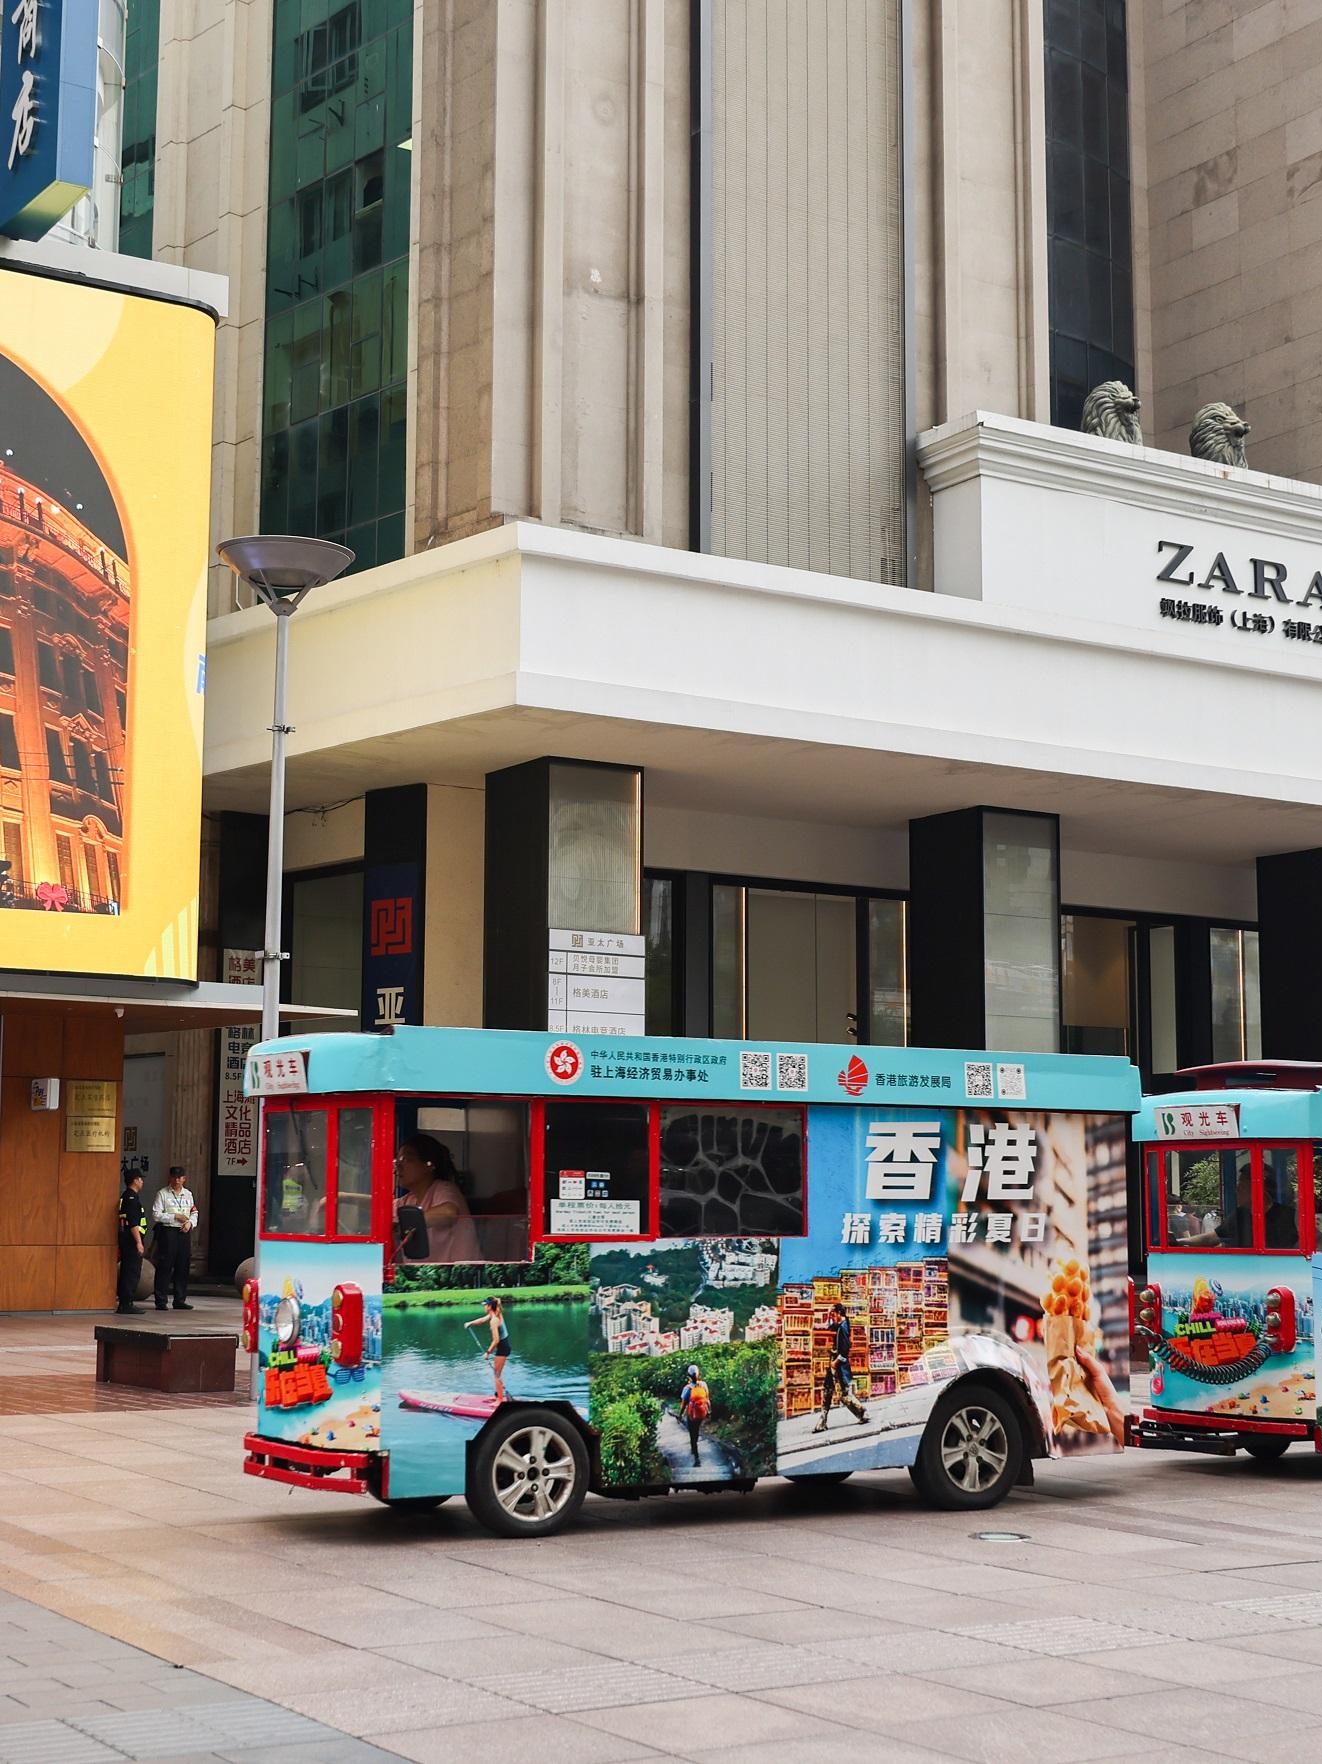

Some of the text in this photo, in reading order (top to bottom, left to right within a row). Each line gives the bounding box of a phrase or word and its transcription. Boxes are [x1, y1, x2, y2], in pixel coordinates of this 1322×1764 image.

[587, 937, 624, 949] 亚太广场
[228, 956, 256, 973] 格美
[573, 987, 609, 1000] 格美酒店
[375, 986, 406, 1025] 亚
[590, 1051, 727, 1066] 中华人民共和国香港特别行政区政府
[225, 1073, 242, 1081] 8.5F
[590, 1065, 709, 1083] 驻上海经济贸易办事处
[875, 1073, 951, 1089] 香港旅游发展局
[225, 1106, 251, 1121] 文化
[1180, 1111, 1229, 1127] 观光车
[224, 1122, 251, 1137] 精品
[223, 1139, 251, 1155] 酒店
[226, 1157, 237, 1166] 7F
[864, 1121, 1037, 1202] 香港
[840, 1212, 1046, 1244] 探索精彩夏日
[1174, 1321, 1217, 1336] CHILL
